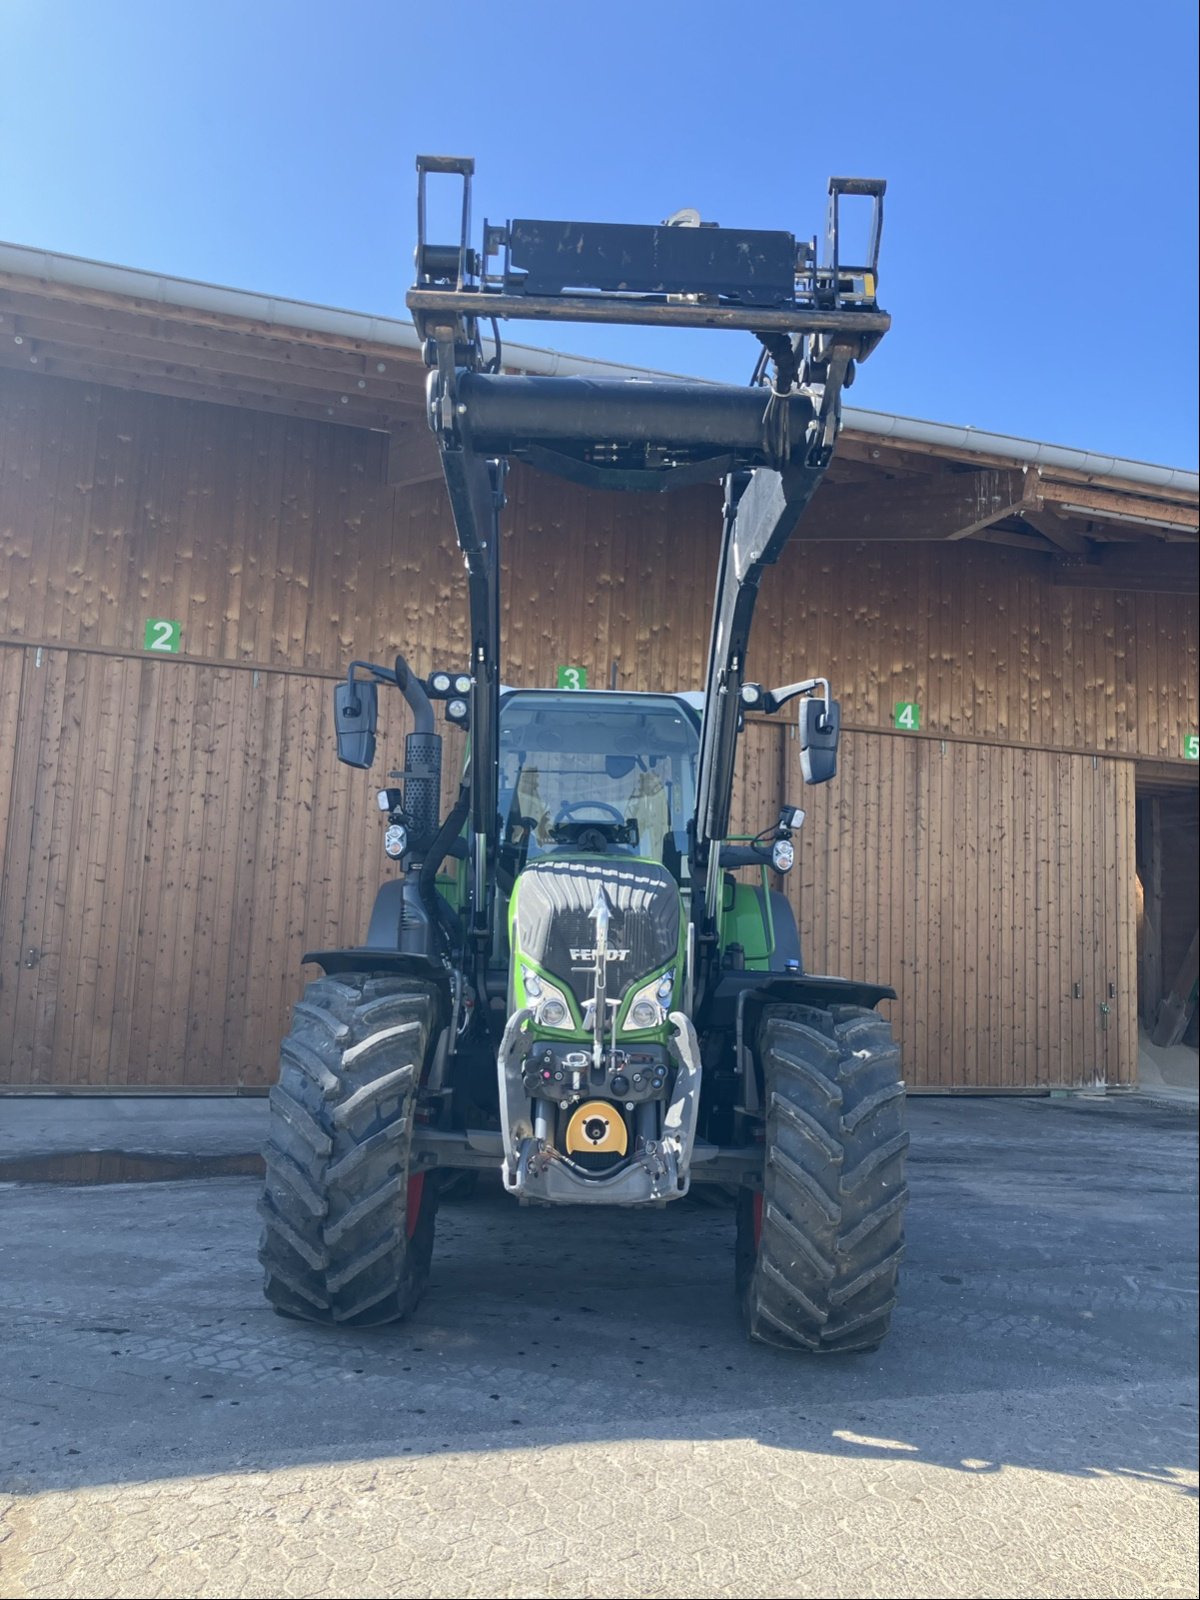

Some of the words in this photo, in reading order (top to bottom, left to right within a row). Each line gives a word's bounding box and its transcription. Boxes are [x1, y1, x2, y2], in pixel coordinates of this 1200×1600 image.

[151, 621, 173, 651] 2
[563, 668, 580, 690] 3
[899, 704, 914, 728] 4
[1189, 736, 1200, 759] 5
